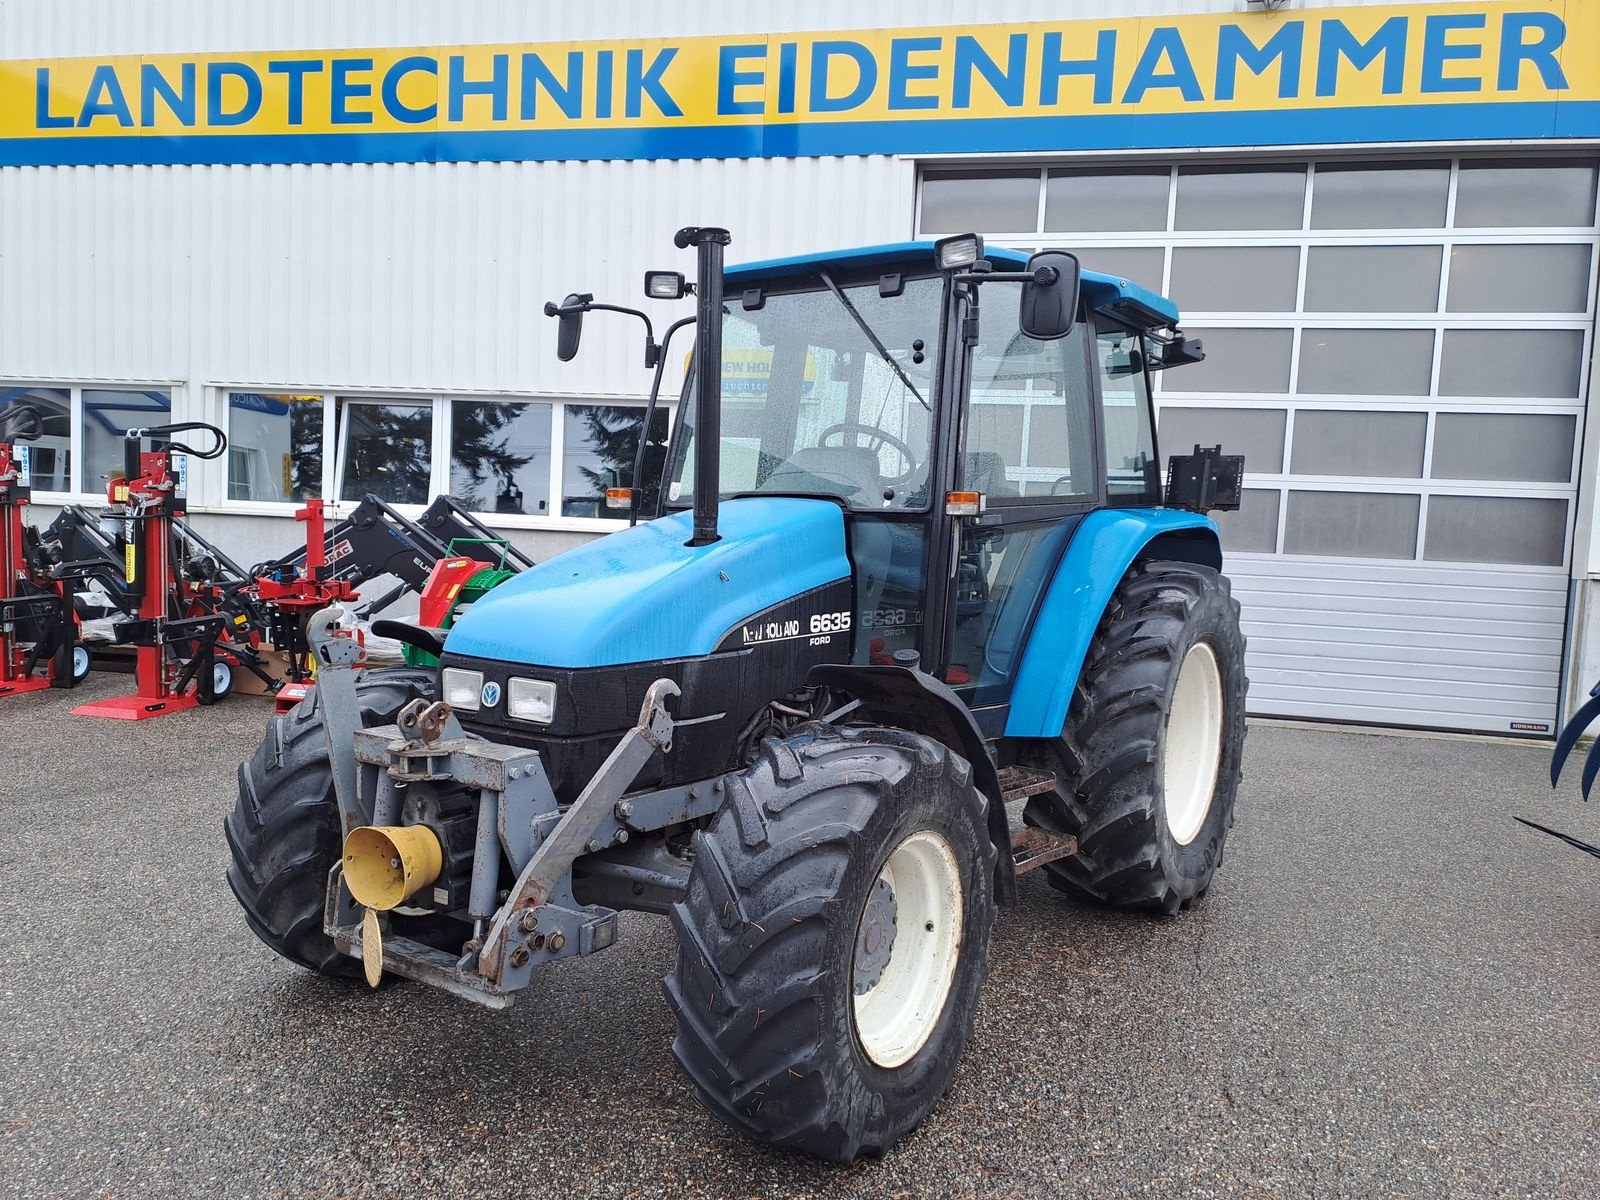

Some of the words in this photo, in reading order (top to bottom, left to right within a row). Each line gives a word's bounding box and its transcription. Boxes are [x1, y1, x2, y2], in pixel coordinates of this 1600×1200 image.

[36, 48, 683, 128] LANDTECHNIK
[717, 10, 1568, 115] EIDENHAMMER
[810, 611, 851, 633] 6635
[809, 635, 831, 647] FORD
